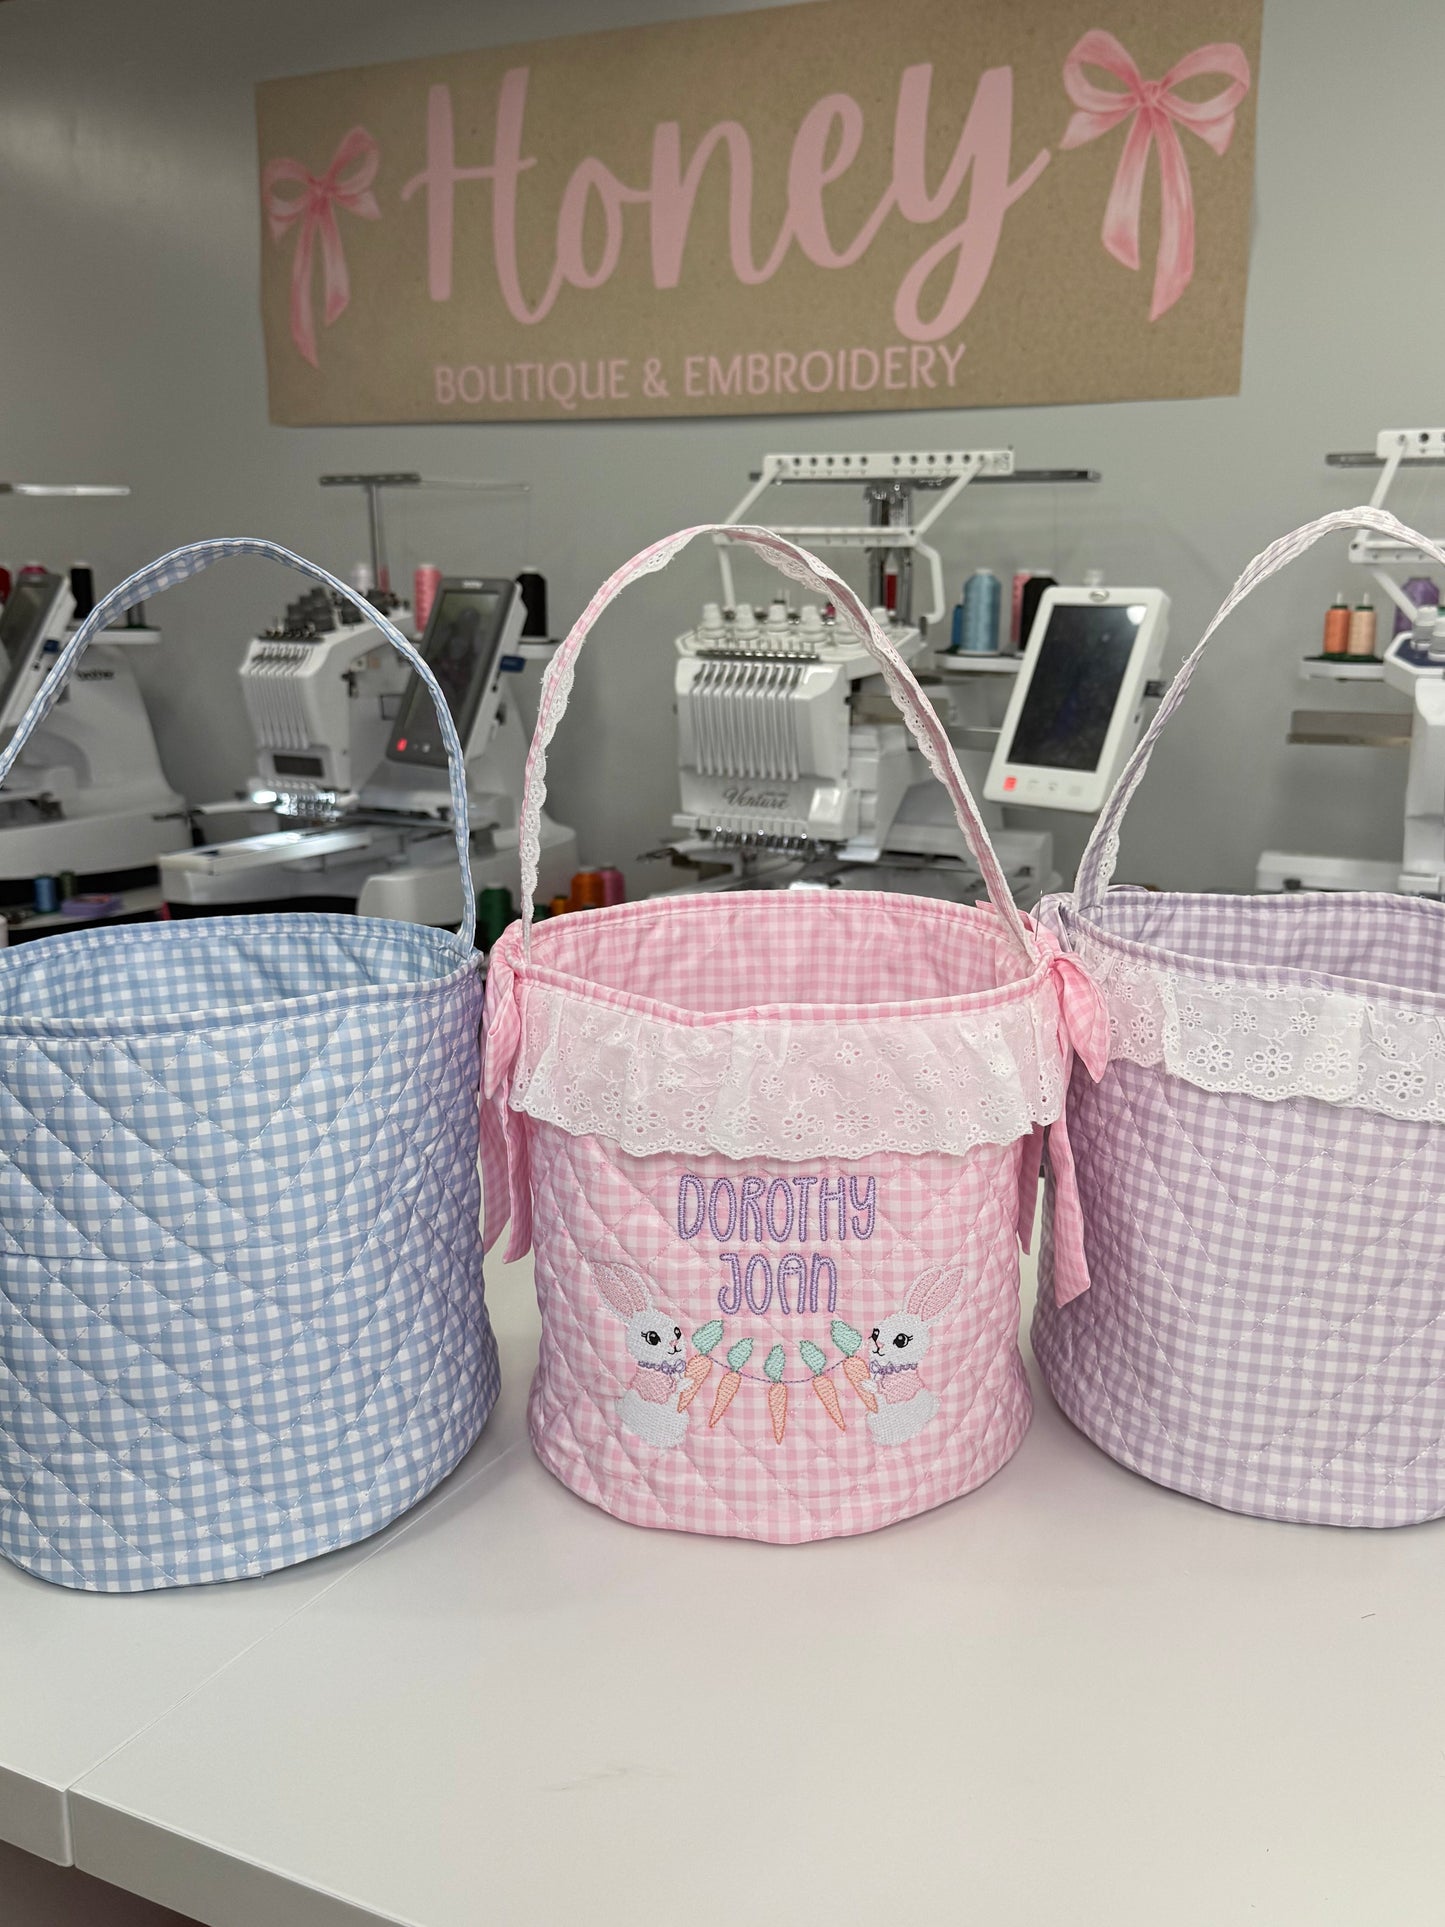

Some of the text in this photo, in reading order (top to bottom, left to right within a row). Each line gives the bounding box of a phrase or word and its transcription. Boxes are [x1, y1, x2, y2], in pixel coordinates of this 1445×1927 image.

[402, 63, 1051, 341] Honey
[435, 343, 966, 411] BOUTIQUE & EMBROIDERY
[723, 786, 788, 809] Venture
[678, 1174, 876, 1242] DOROTHY
[718, 1252, 838, 1315] JOAN
